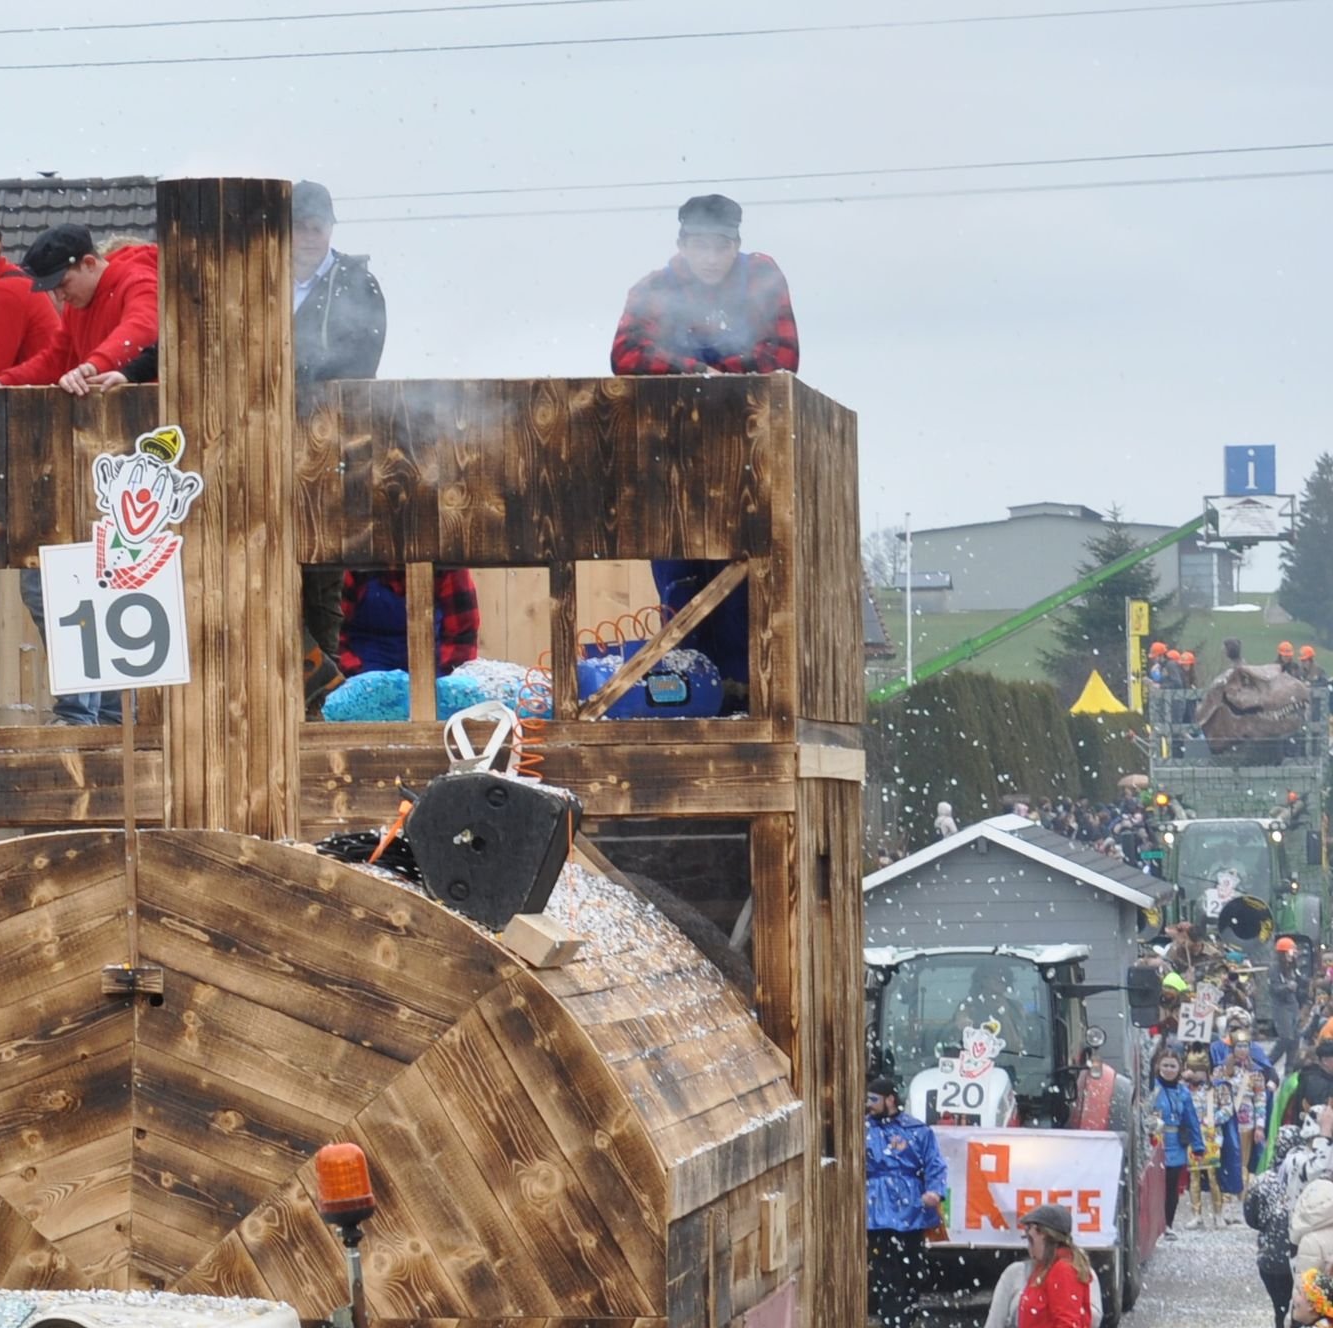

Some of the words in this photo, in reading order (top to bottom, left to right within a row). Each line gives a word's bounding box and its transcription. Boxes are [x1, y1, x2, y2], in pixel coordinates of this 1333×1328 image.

[58, 592, 171, 681] 19
[1184, 1019, 1206, 1038] 21
[941, 1080, 985, 1109] 20
